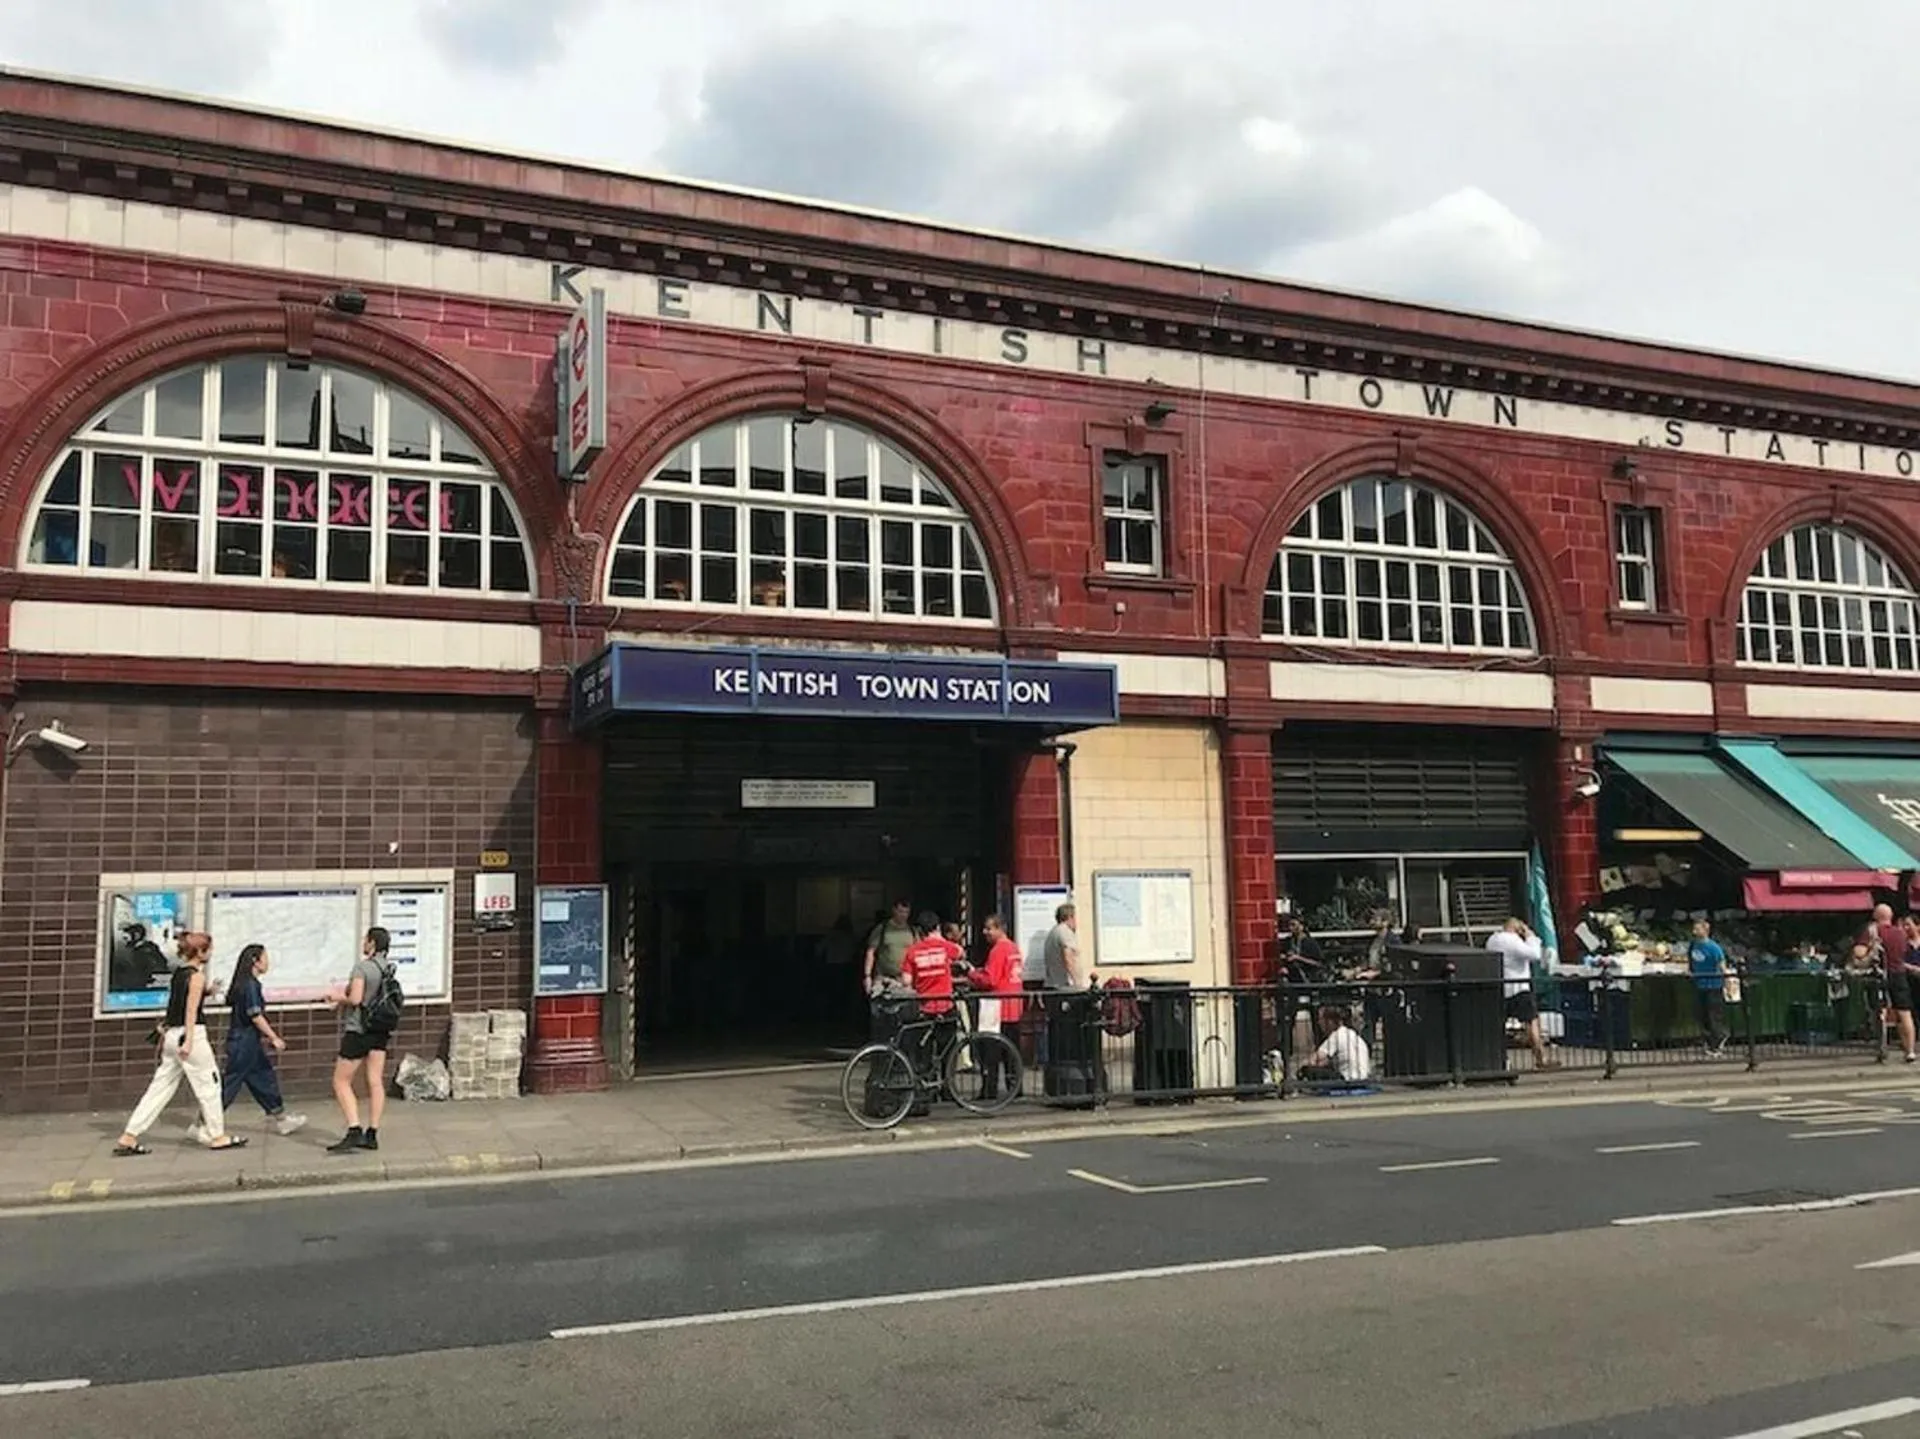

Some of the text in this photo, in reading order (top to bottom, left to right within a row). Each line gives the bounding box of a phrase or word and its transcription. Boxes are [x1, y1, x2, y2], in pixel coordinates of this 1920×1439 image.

[552, 265, 1913, 476] KENTISH TOWN STATIO
[714, 669, 1051, 704] KENTISH TOWN STATION
